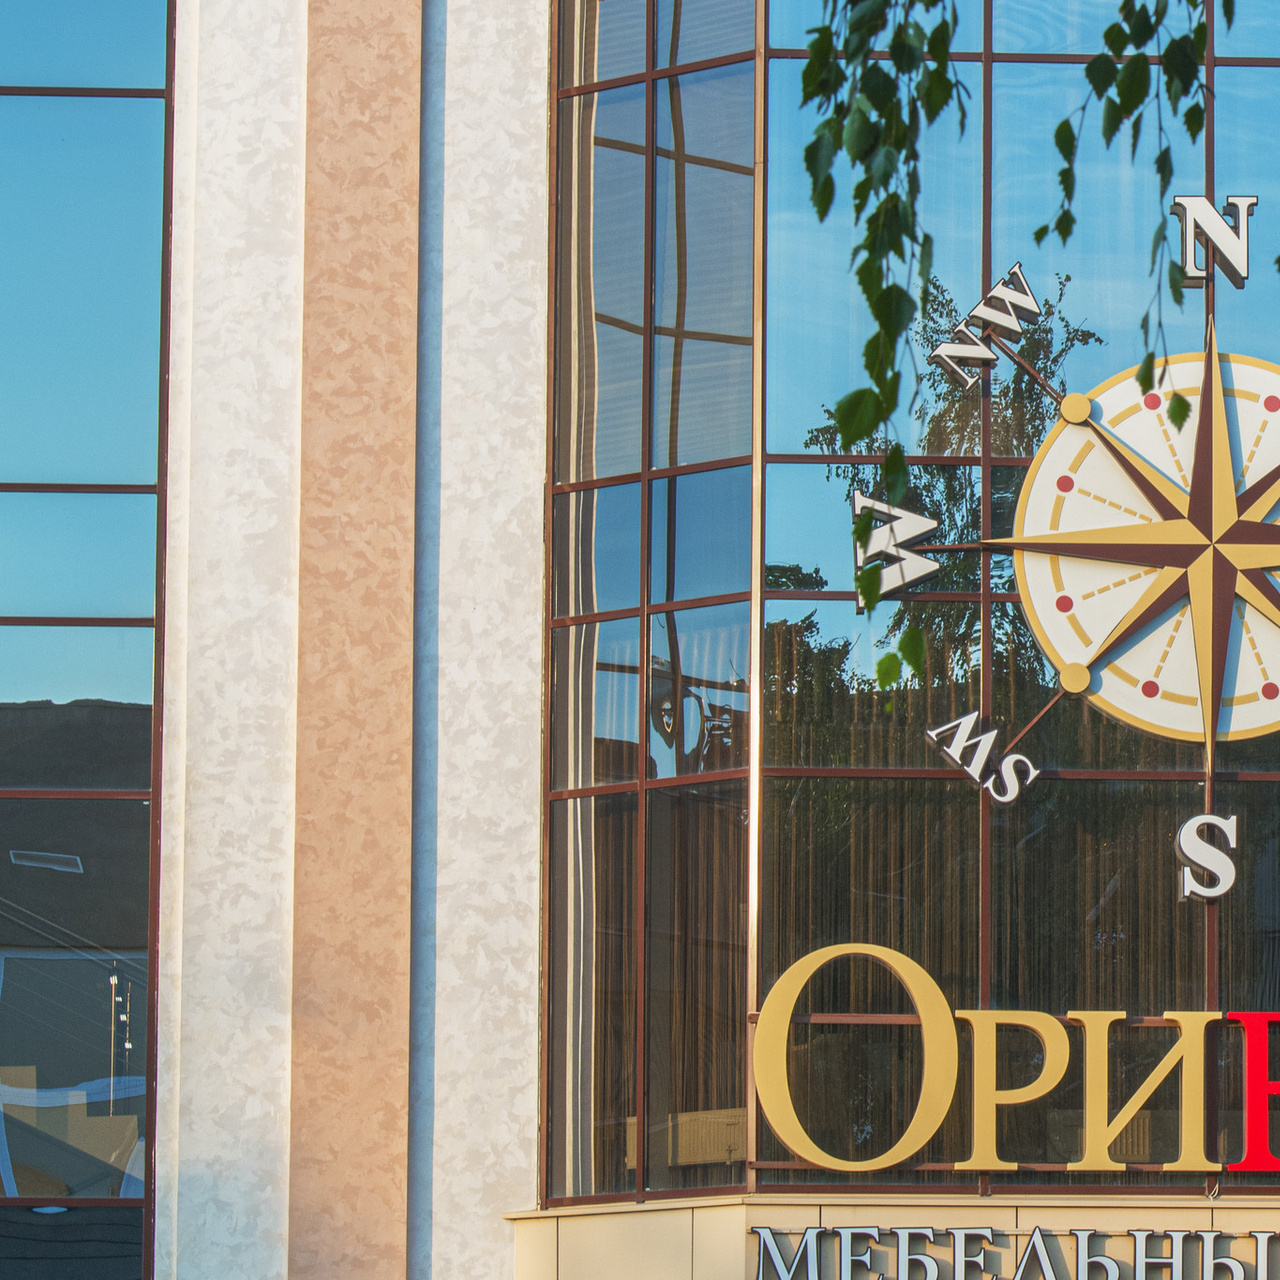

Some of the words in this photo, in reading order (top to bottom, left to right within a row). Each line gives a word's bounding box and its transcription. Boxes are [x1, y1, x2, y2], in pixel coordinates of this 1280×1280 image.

[1172, 195, 1258, 282] N
[929, 261, 1042, 392] NW
[853, 489, 940, 613] W
[926, 711, 1041, 803] SW
[1178, 814, 1238, 899] S
